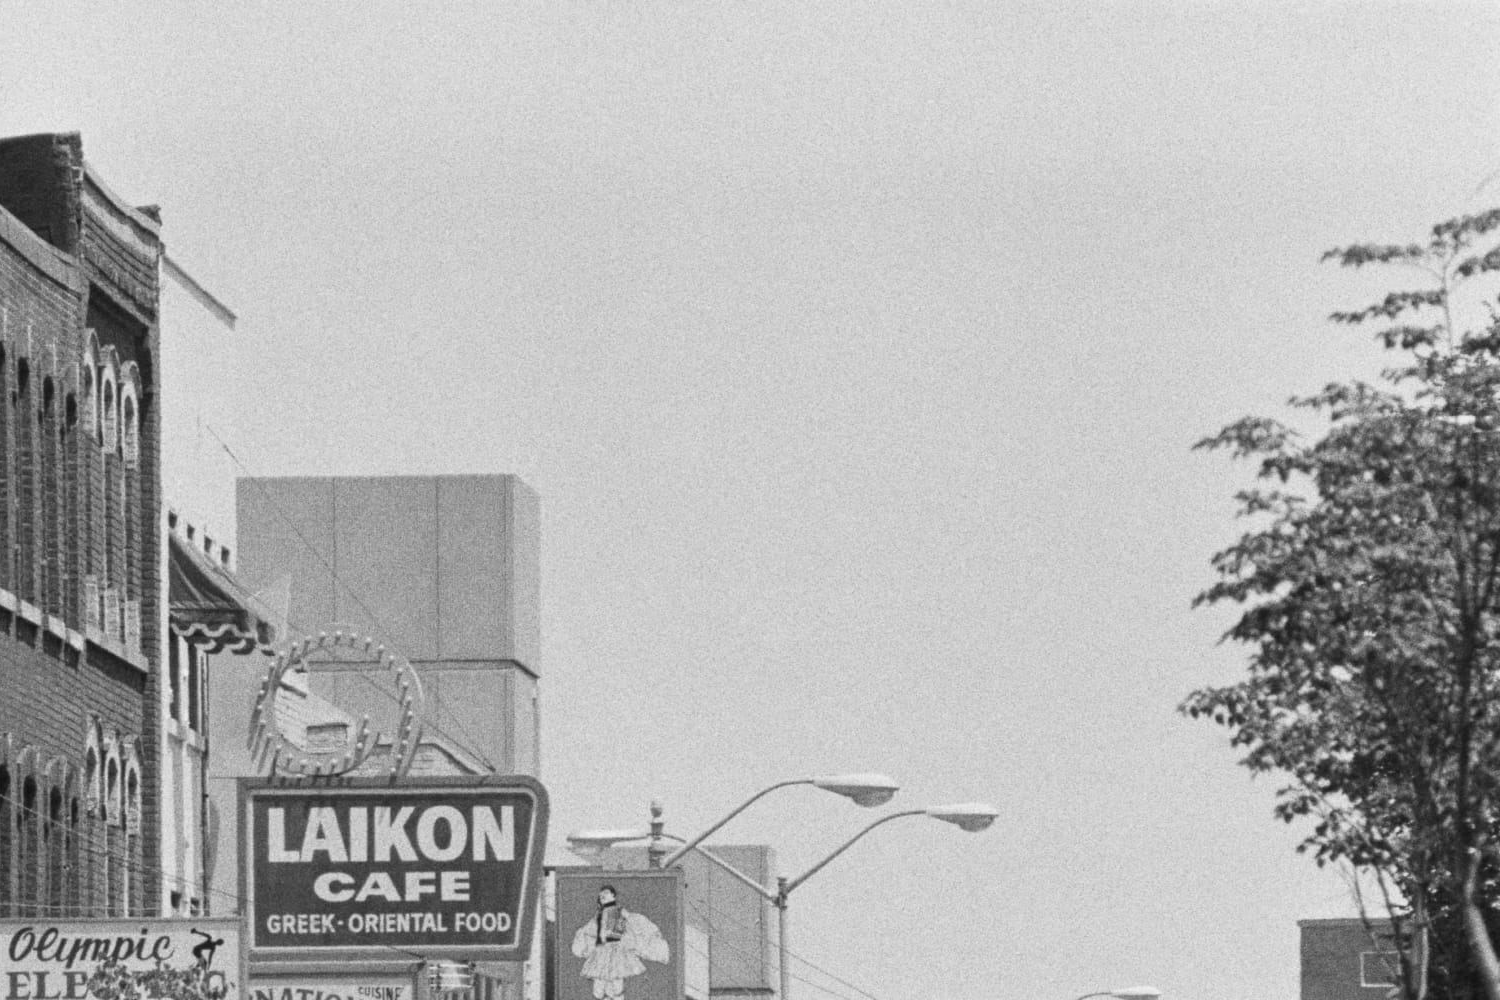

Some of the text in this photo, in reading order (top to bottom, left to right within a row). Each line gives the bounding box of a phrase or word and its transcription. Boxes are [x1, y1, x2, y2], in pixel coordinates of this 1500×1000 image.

[268, 804, 515, 863] LAIKON
[313, 871, 470, 903] CAFE
[454, 912, 512, 932] FOOD
[8, 926, 175, 969] Olympic
